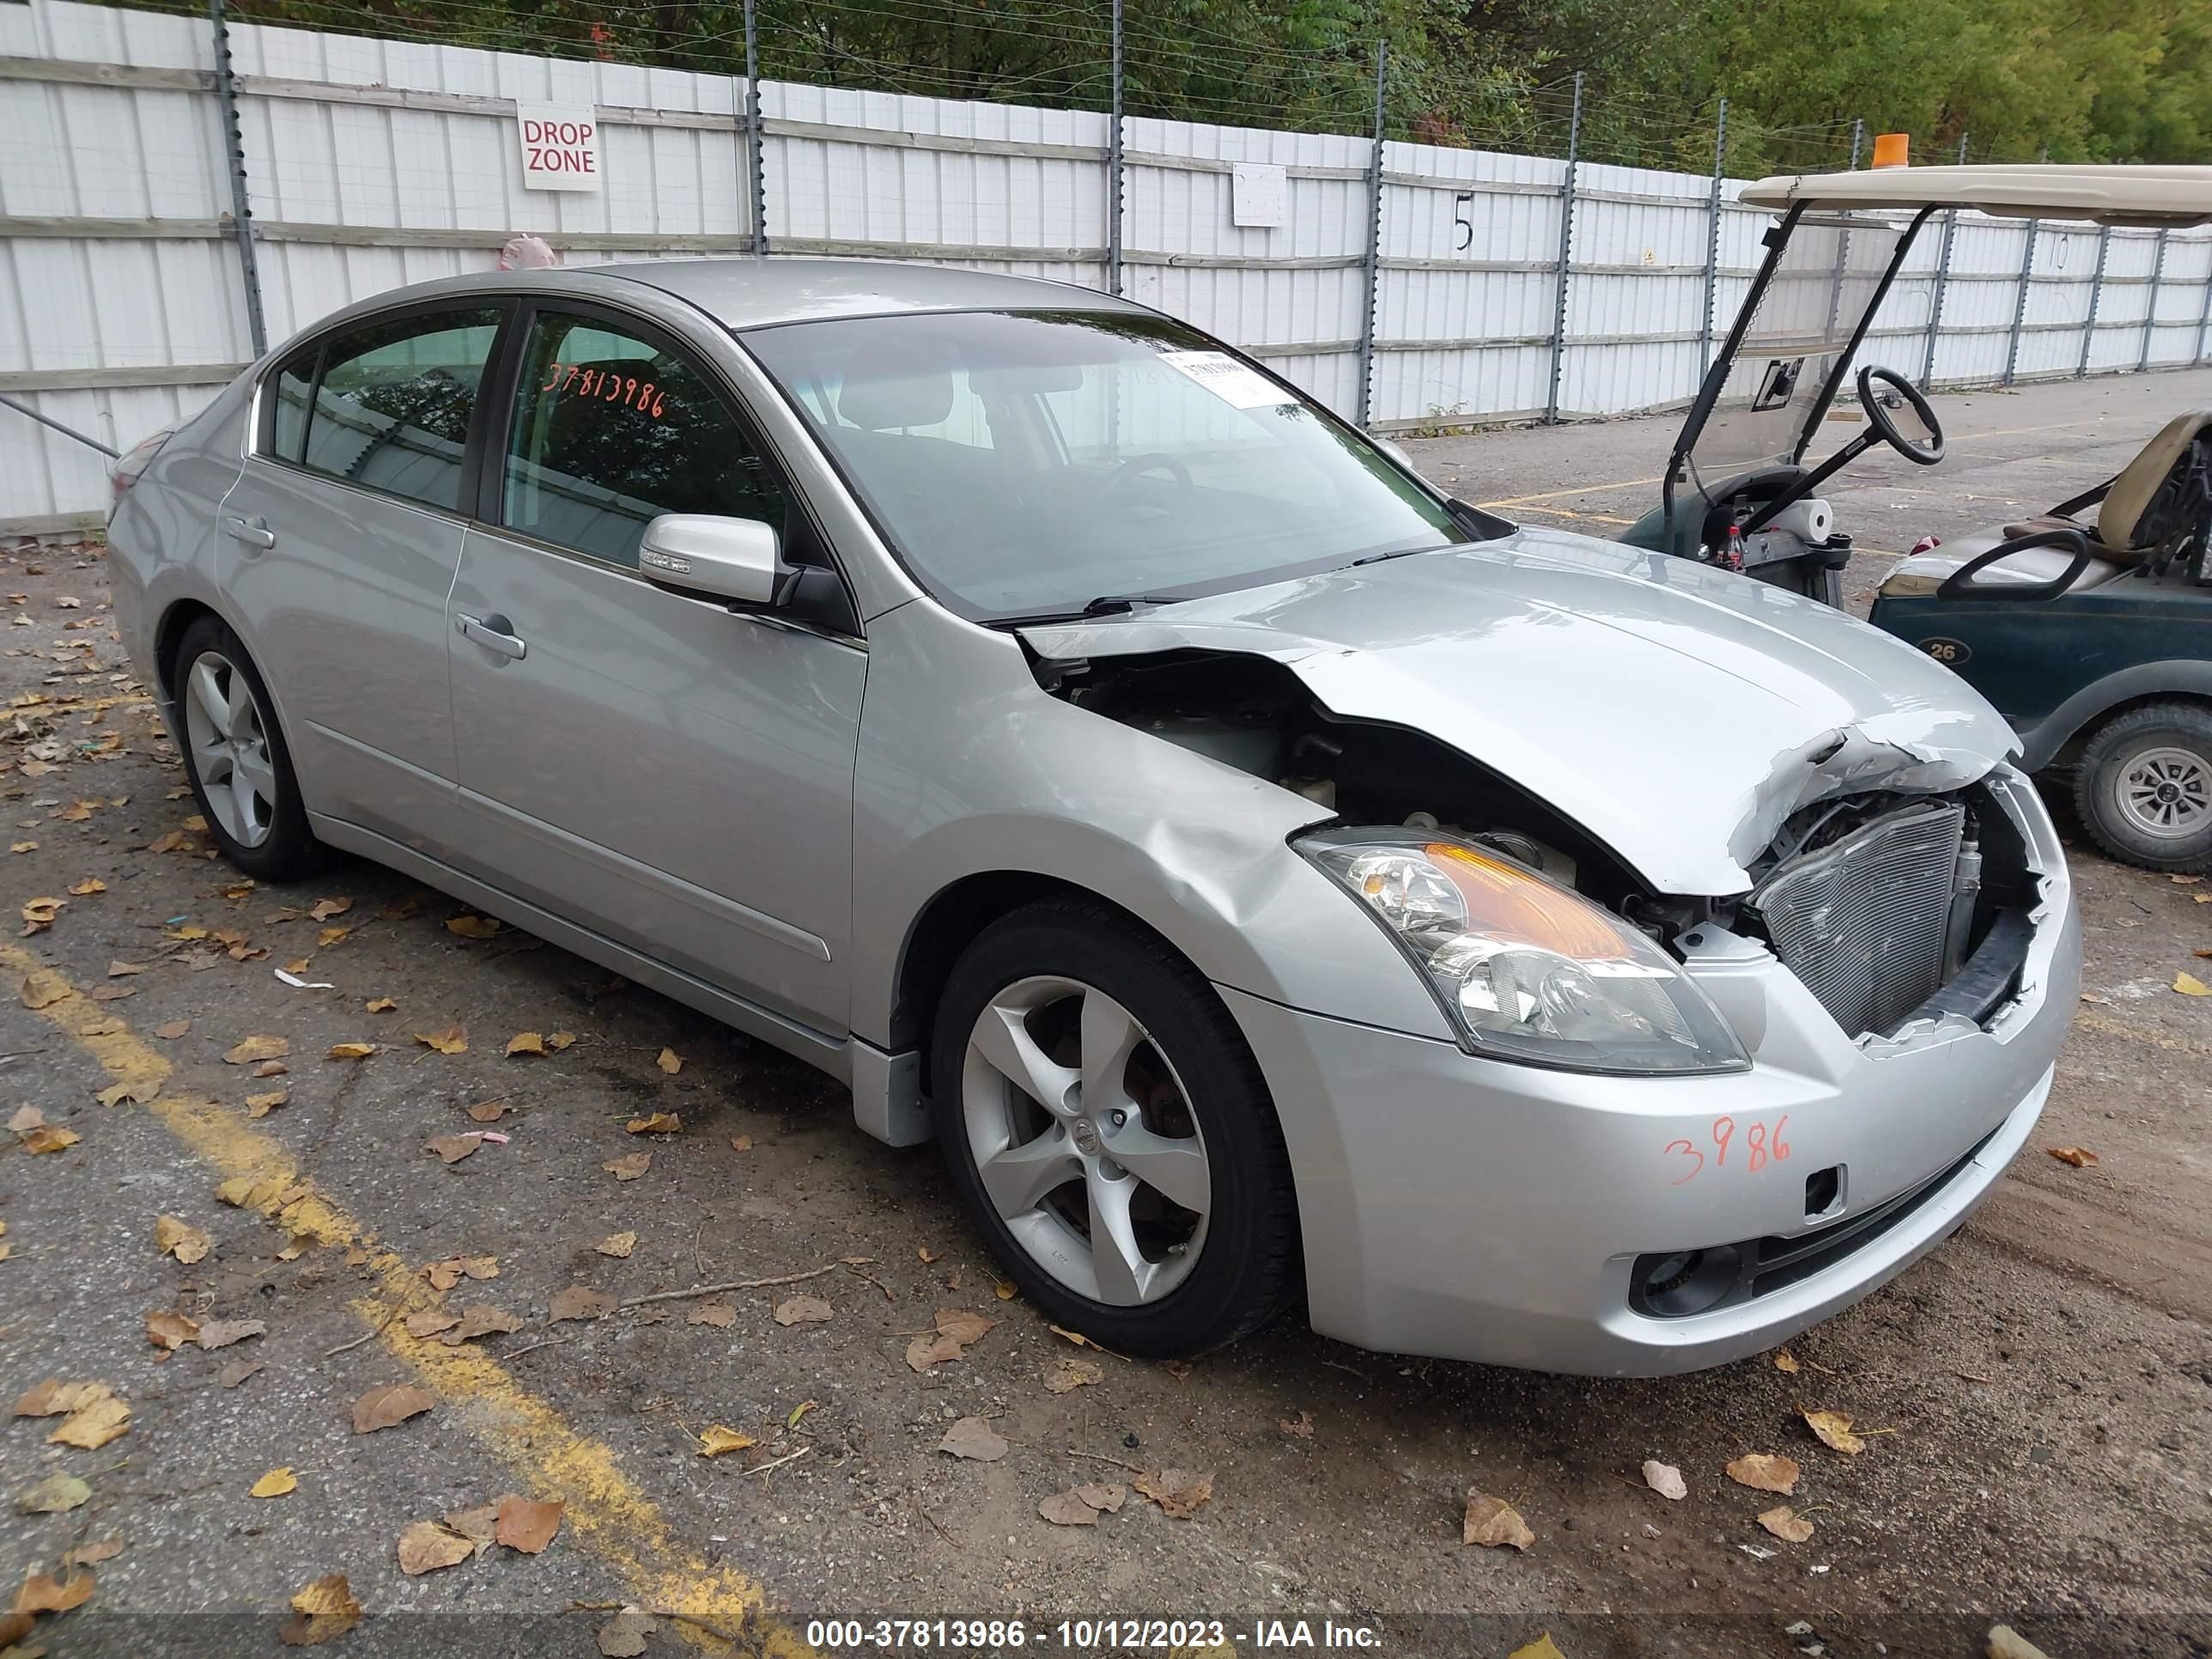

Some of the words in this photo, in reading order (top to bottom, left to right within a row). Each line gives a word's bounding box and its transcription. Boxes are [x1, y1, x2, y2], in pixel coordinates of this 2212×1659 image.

[523, 119, 592, 145] DROP
[527, 148, 595, 173] ZONE
[1455, 194, 1474, 251] 5
[543, 363, 665, 418] 37813986
[1930, 643, 1956, 660] 26
[1663, 1115, 1790, 1186] 3986
